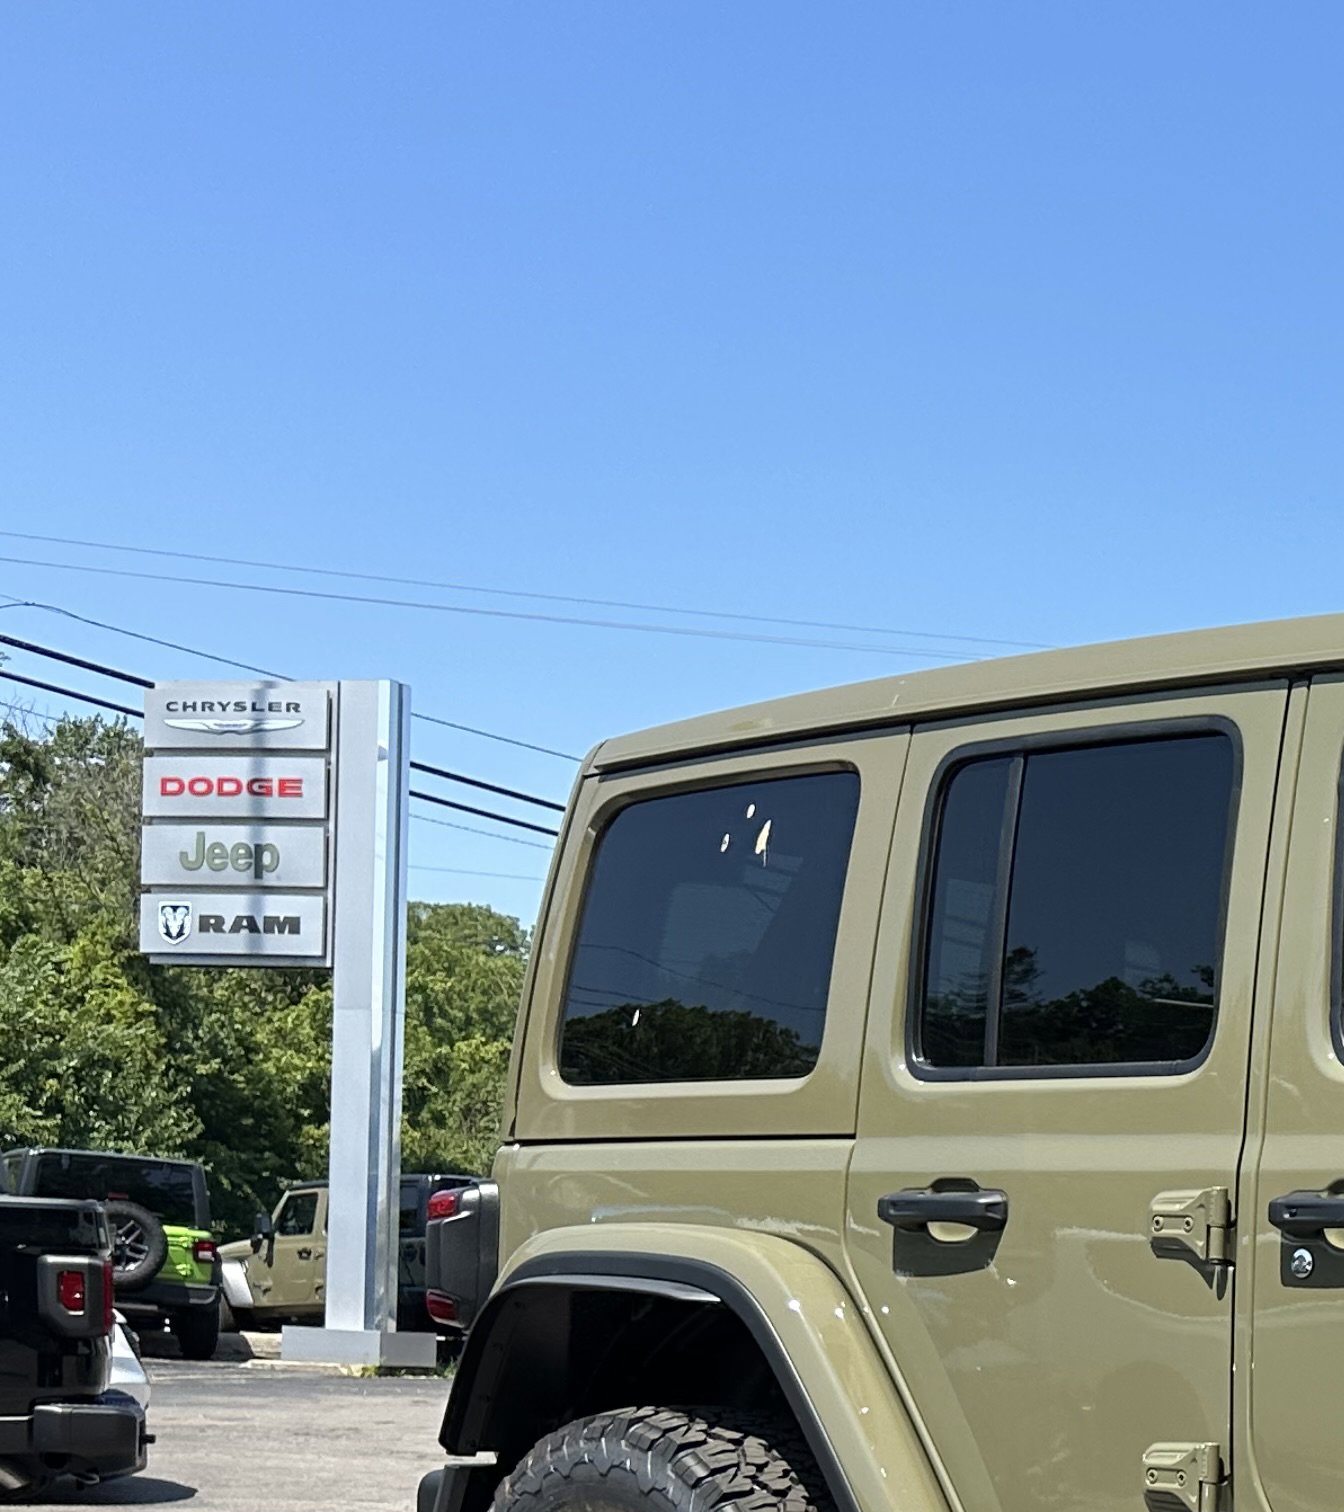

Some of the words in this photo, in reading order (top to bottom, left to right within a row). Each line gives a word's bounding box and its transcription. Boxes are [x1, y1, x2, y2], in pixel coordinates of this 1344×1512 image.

[165, 701, 302, 713] CHRYSLER
[160, 776, 304, 798] DODGE
[179, 831, 280, 880] Jeep
[198, 914, 301, 935] RAM
